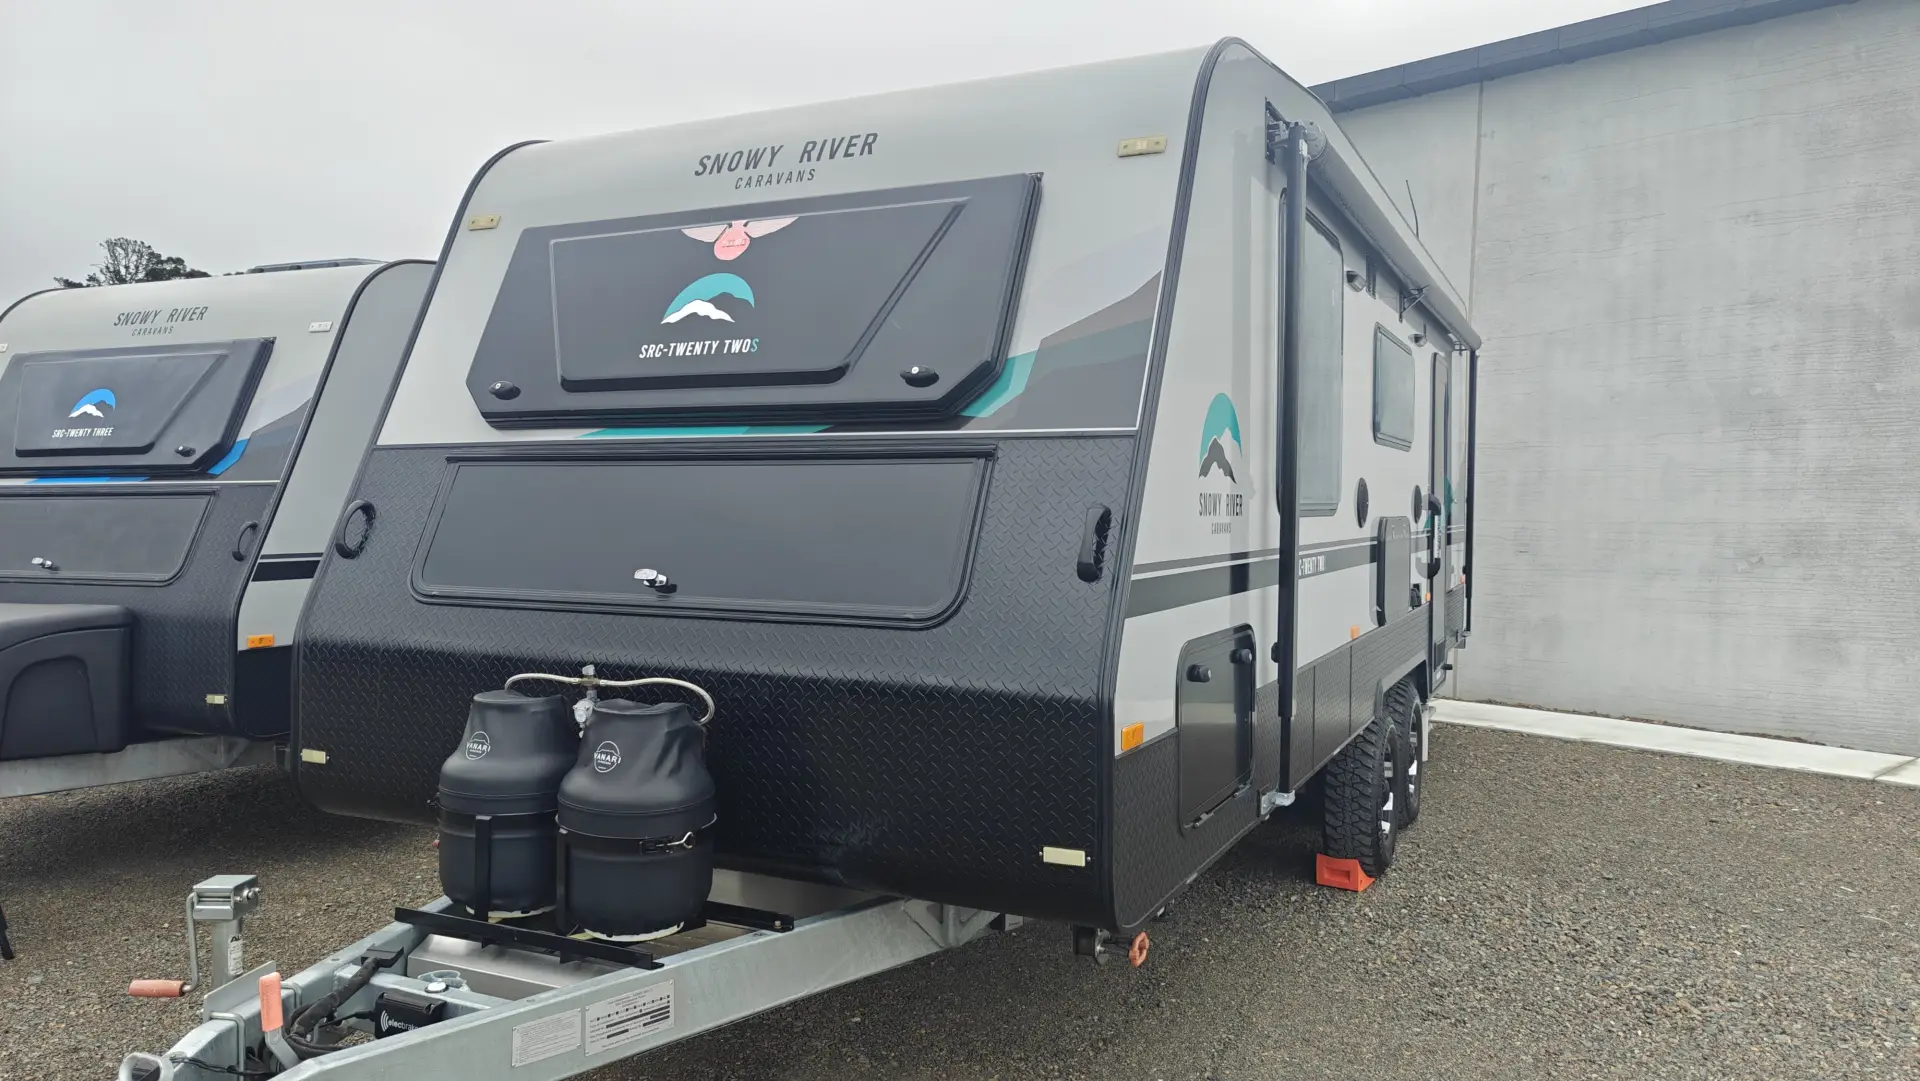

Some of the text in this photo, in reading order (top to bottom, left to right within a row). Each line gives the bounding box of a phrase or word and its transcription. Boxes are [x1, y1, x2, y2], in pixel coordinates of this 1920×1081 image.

[694, 132, 878, 177] SNOWY RIVER
[734, 168, 816, 190] CARAVANS
[113, 306, 208, 327] SNOWY RIVER
[131, 325, 174, 337] CARAVANS
[638, 338, 760, 359] SRC-TWENTY TWOS
[92, 427, 114, 437] THREE
[1198, 492, 1244, 517] SNOWY RIVER
[593, 751, 622, 764] VANARI
